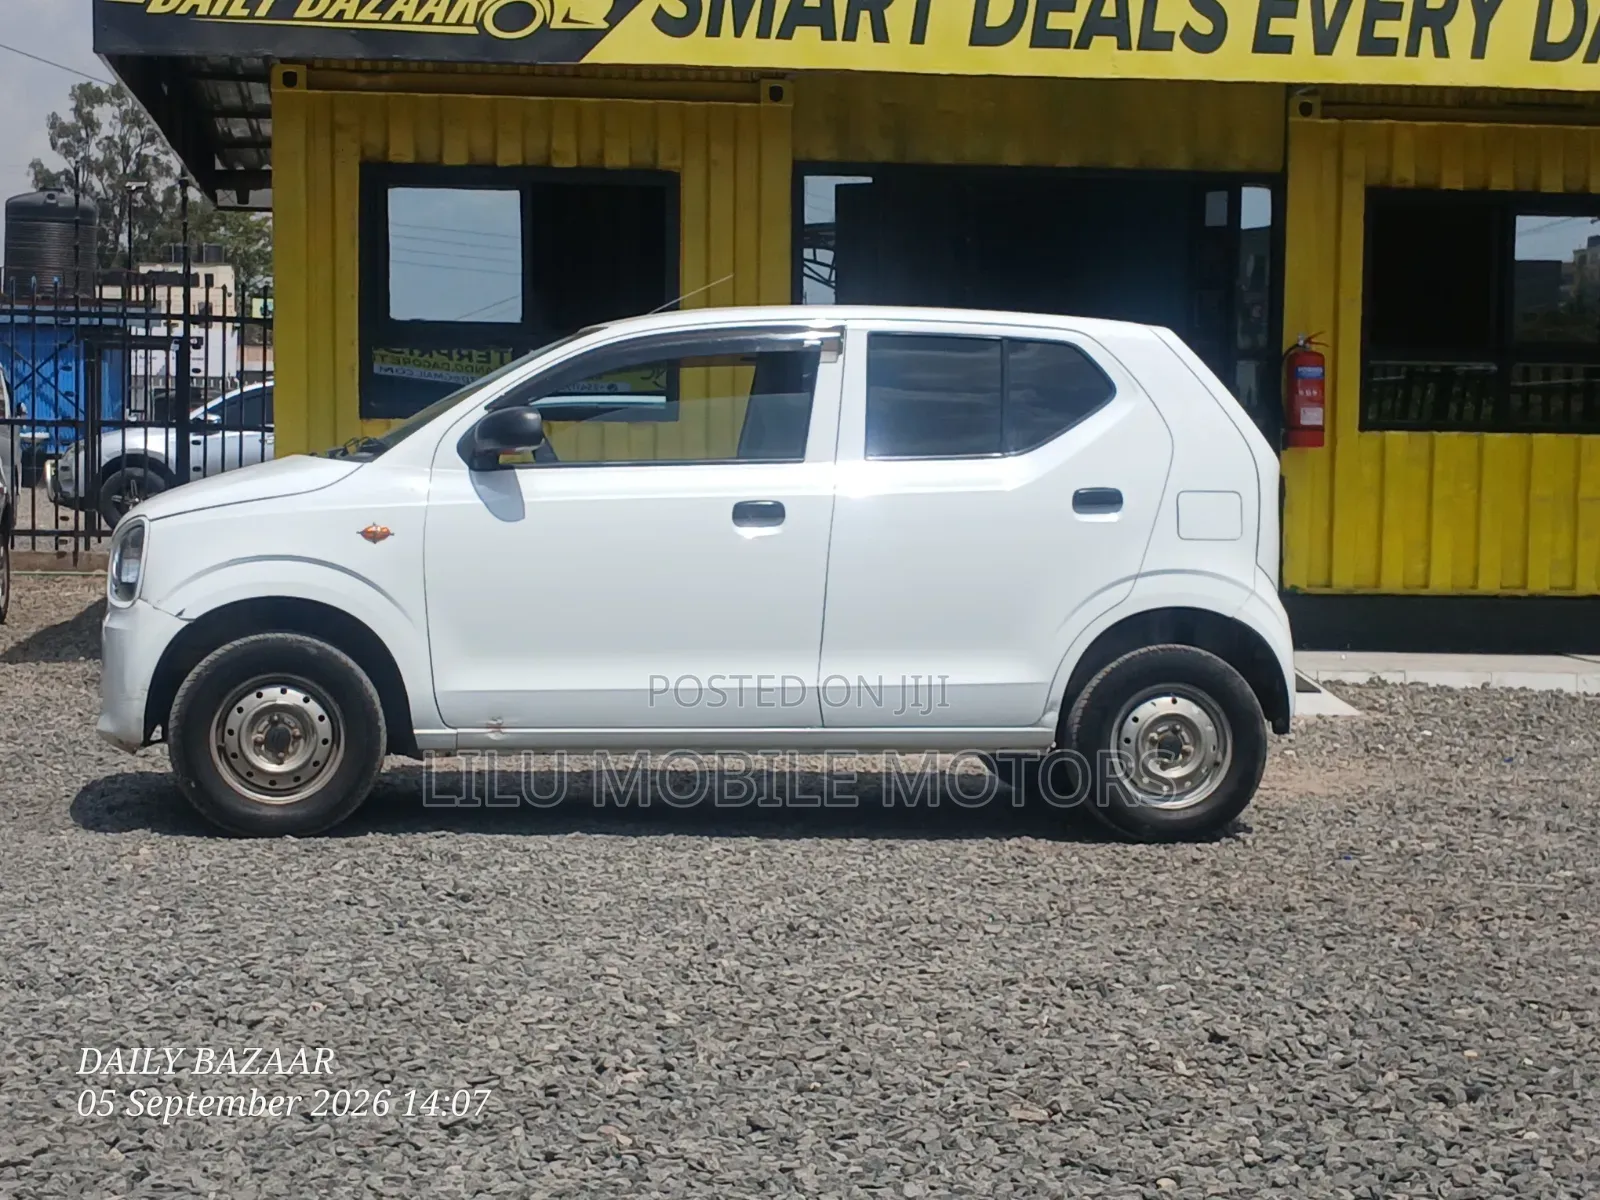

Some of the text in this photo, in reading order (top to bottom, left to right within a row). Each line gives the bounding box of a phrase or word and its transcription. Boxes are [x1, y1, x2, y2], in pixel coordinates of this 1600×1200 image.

[968, 0, 1228, 54] DEALS
[1251, 0, 1502, 60] EVERY
[1529, 0, 1600, 64] D
